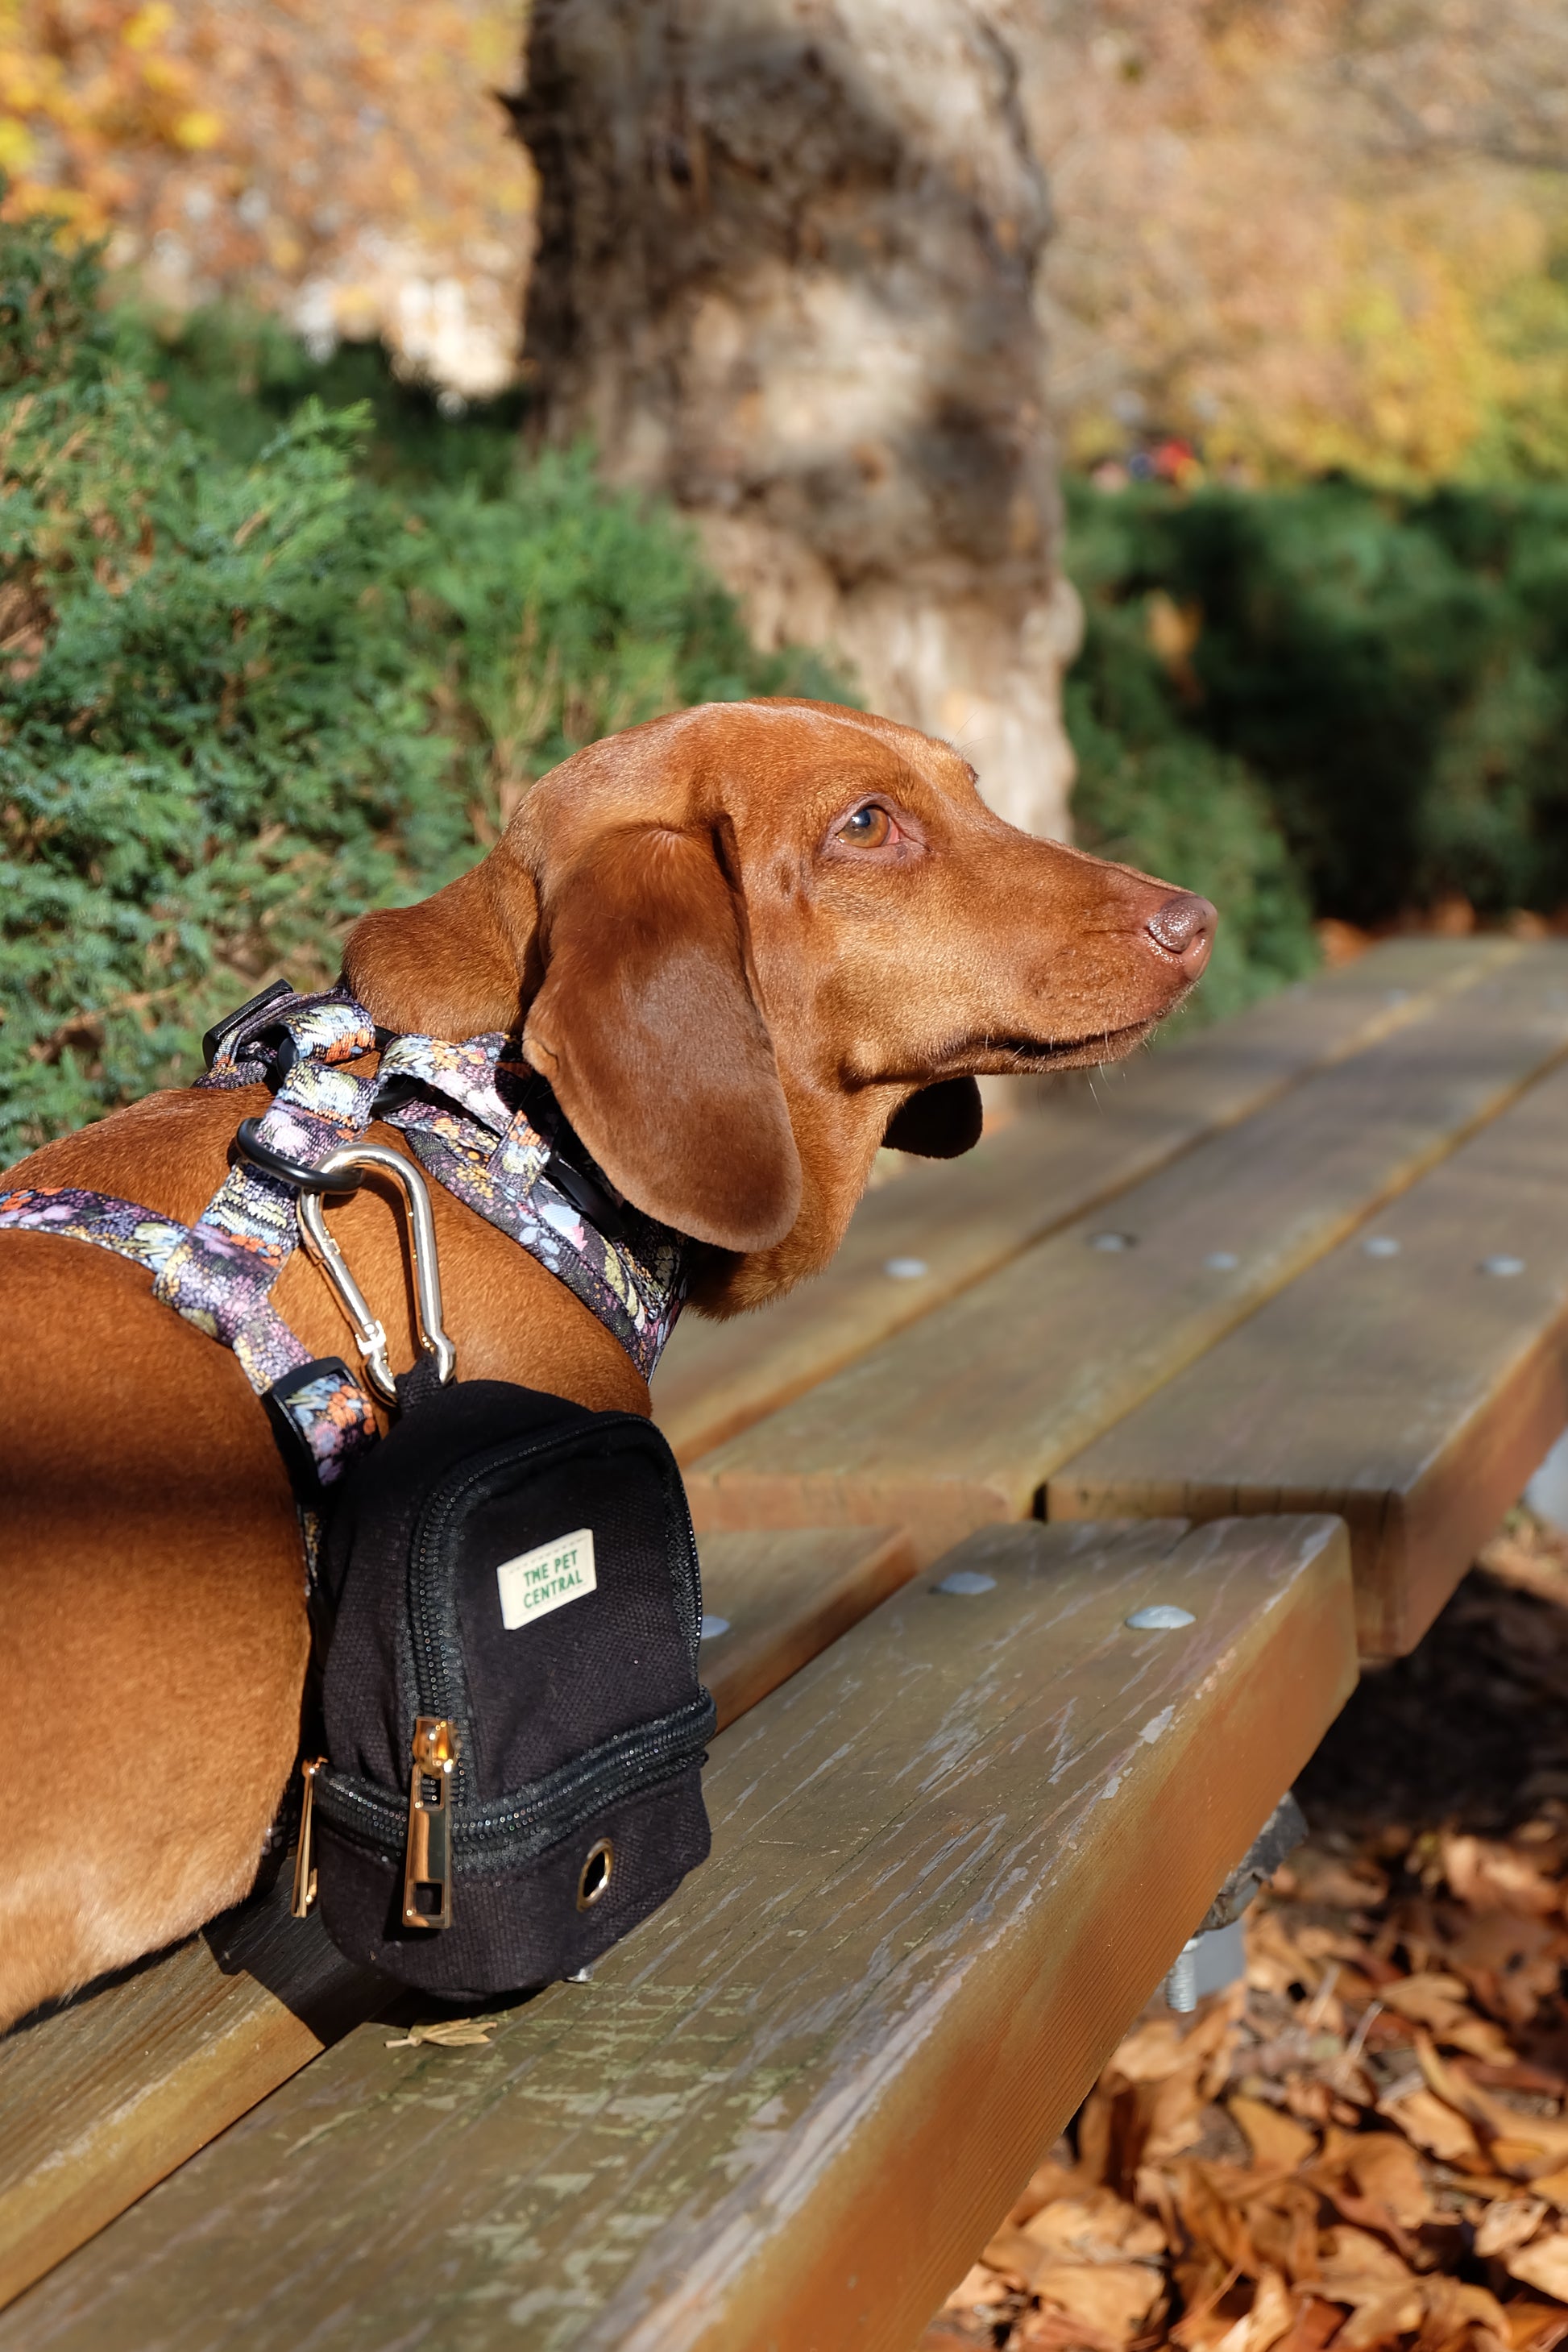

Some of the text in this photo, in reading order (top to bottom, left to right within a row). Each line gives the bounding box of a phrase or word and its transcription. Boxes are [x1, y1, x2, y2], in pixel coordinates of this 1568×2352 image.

[524, 1549, 578, 1587] THE PET
[524, 1570, 583, 1608] CENTRAL
